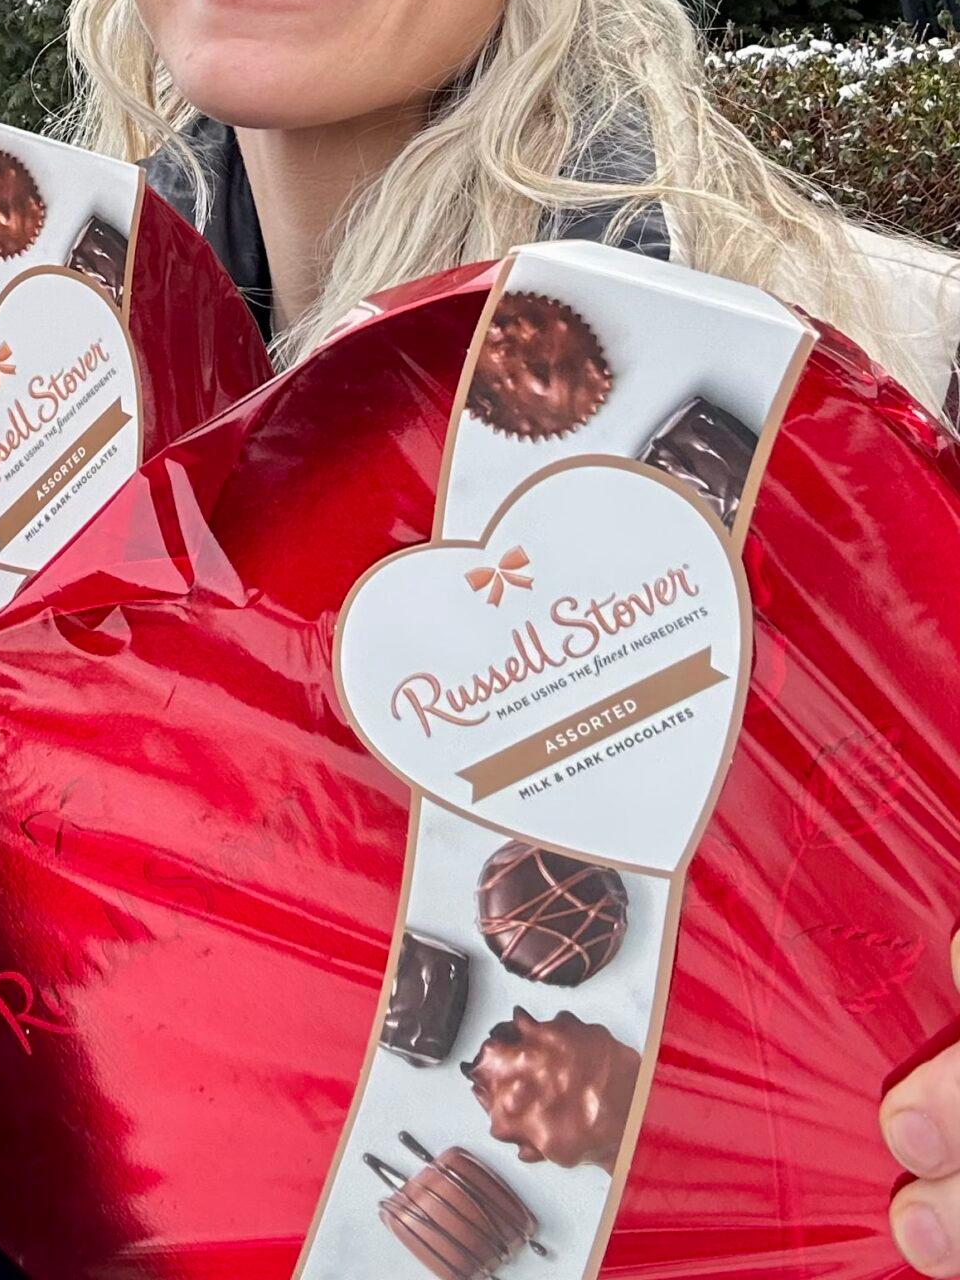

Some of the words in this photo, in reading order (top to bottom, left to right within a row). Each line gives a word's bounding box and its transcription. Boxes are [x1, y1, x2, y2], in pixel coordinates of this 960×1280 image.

[4, 460, 25, 482] MADE
[23, 440, 45, 462] USING
[44, 426, 58, 442] THE
[56, 405, 75, 434] finest
[75, 367, 117, 410] INGREDIENTS
[28, 343, 110, 424] Stover
[25, 520, 44, 542] MILK
[50, 492, 72, 516] DARK
[71, 444, 118, 494] CHOCOLATES
[36, 446, 86, 501] ASSORTED
[390, 620, 568, 738] Russell
[550, 567, 700, 659] Stover
[496, 696, 531, 720] MADE
[531, 678, 568, 702] USING
[568, 664, 593, 683] THE
[592, 644, 629, 678] finest
[630, 606, 709, 652] INGREDIENTS
[518, 777, 552, 800] MILK
[554, 772, 564, 783] &
[566, 752, 605, 777] DARK
[605, 707, 695, 757] CHOCOLATES
[545, 698, 638, 754] ASSORTED
